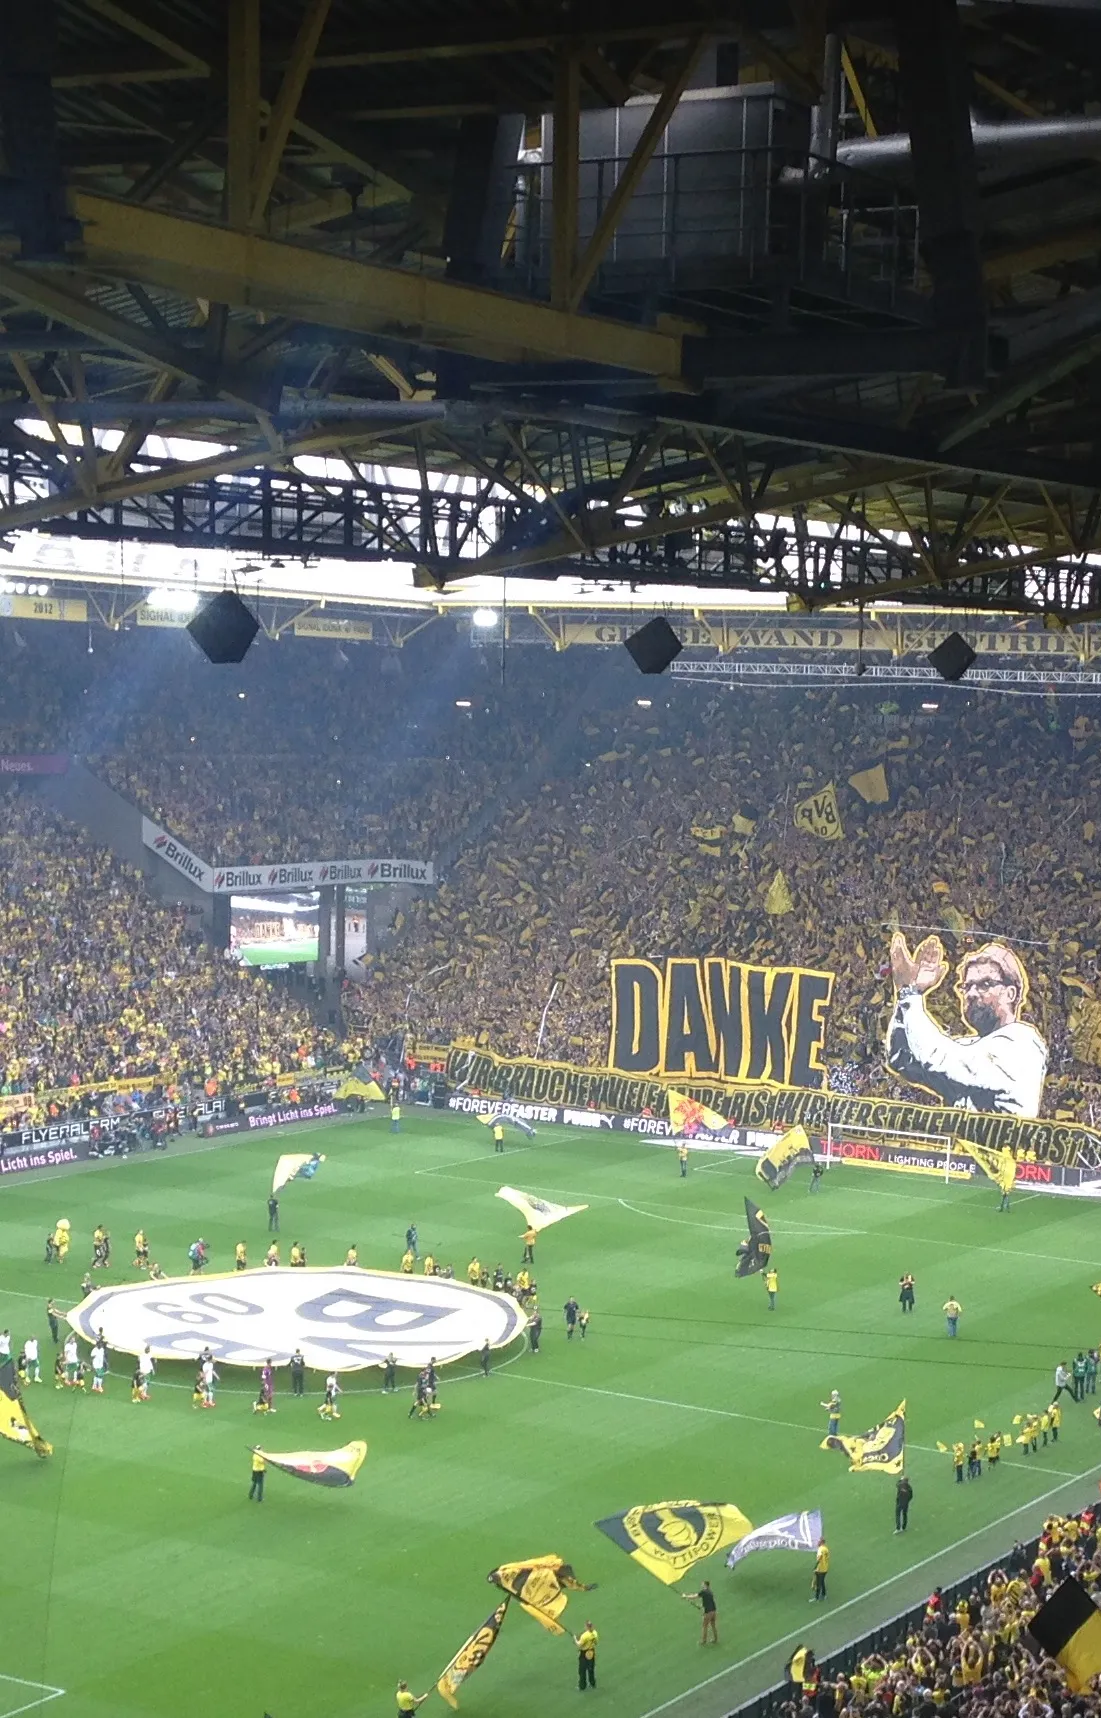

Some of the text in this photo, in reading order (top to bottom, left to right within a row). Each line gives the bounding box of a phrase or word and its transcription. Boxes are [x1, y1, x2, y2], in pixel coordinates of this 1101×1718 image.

[735, 629, 843, 647] WAND
[164, 841, 206, 882] Brillux
[328, 865, 363, 880] Brillux
[380, 862, 428, 880] Brillux
[225, 871, 262, 887] Brillux
[278, 869, 314, 884] Brillux
[610, 958, 834, 1091] DANKE
[493, 1063, 604, 1108] BRAUCHEN
[606, 1075, 663, 1119] VIELE
[728, 1089, 771, 1126] BIS
[774, 1089, 828, 1130] WIR
[829, 1098, 963, 1144] VERSTEHEN
[249, 1112, 276, 1128] Bringt
[277, 1109, 300, 1123] Licht
[300, 1107, 313, 1118] ins
[314, 1102, 338, 1117] Spiel.
[1, 1147, 78, 1173] Licht ins Spiel.
[820, 1139, 880, 1161] THORN
[888, 1153, 935, 1170] LIGHTING
[936, 1159, 977, 1174] PEOPLE
[1016, 1164, 1052, 1182] ORN
